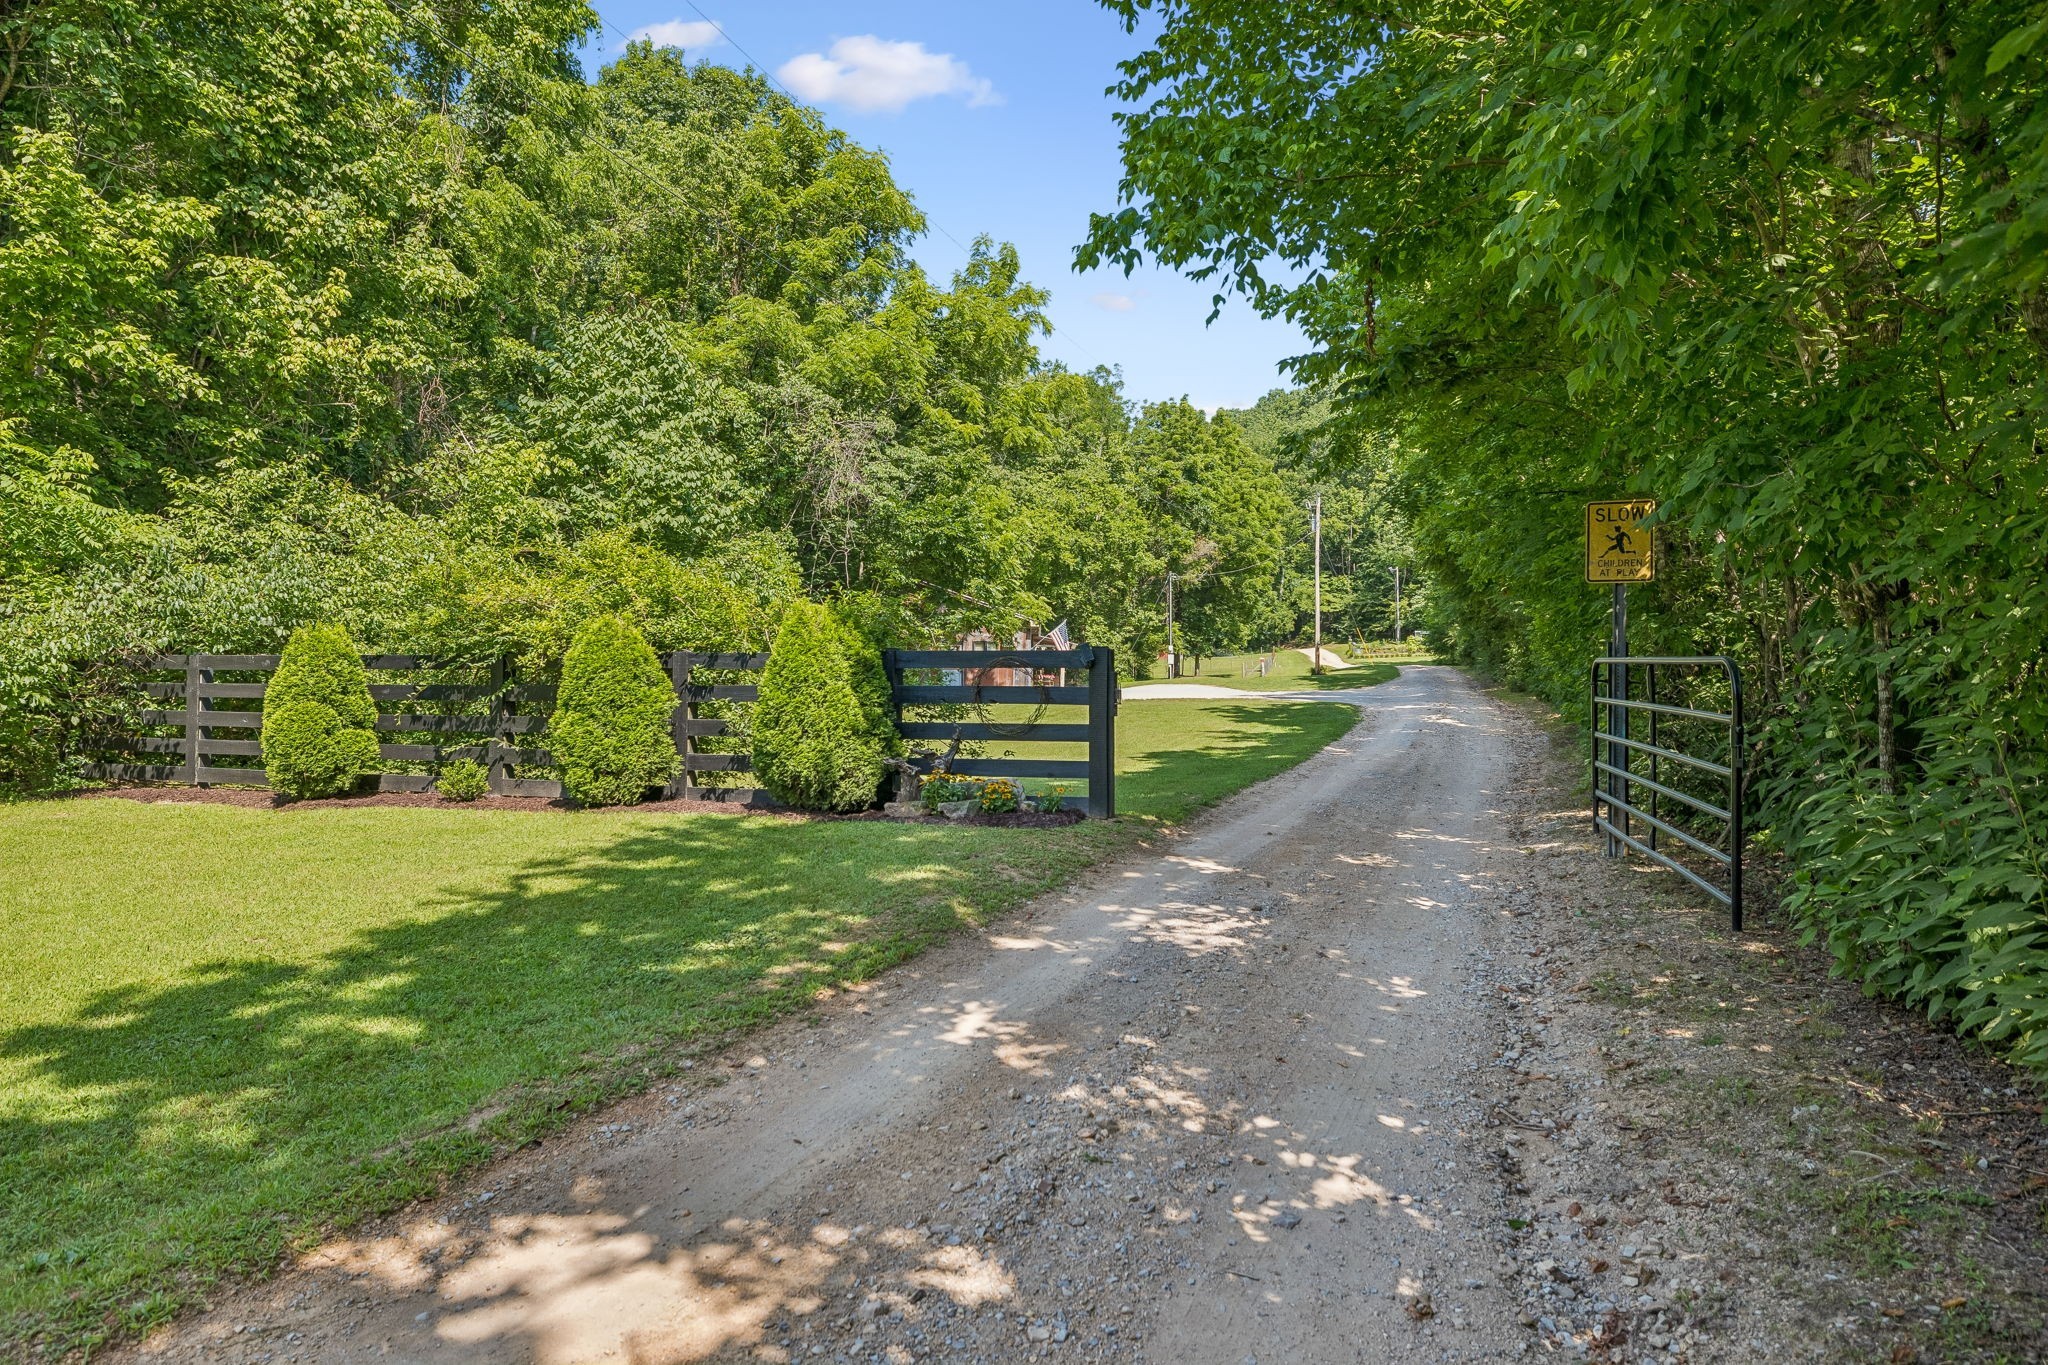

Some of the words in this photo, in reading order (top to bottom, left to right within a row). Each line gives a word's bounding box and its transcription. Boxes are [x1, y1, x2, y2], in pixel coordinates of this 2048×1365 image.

[1595, 505, 1645, 522] SLOW
[1597, 559, 1643, 568] CHILDREN
[1599, 568, 1610, 576] AT
[1616, 568, 1640, 577] PLAY
